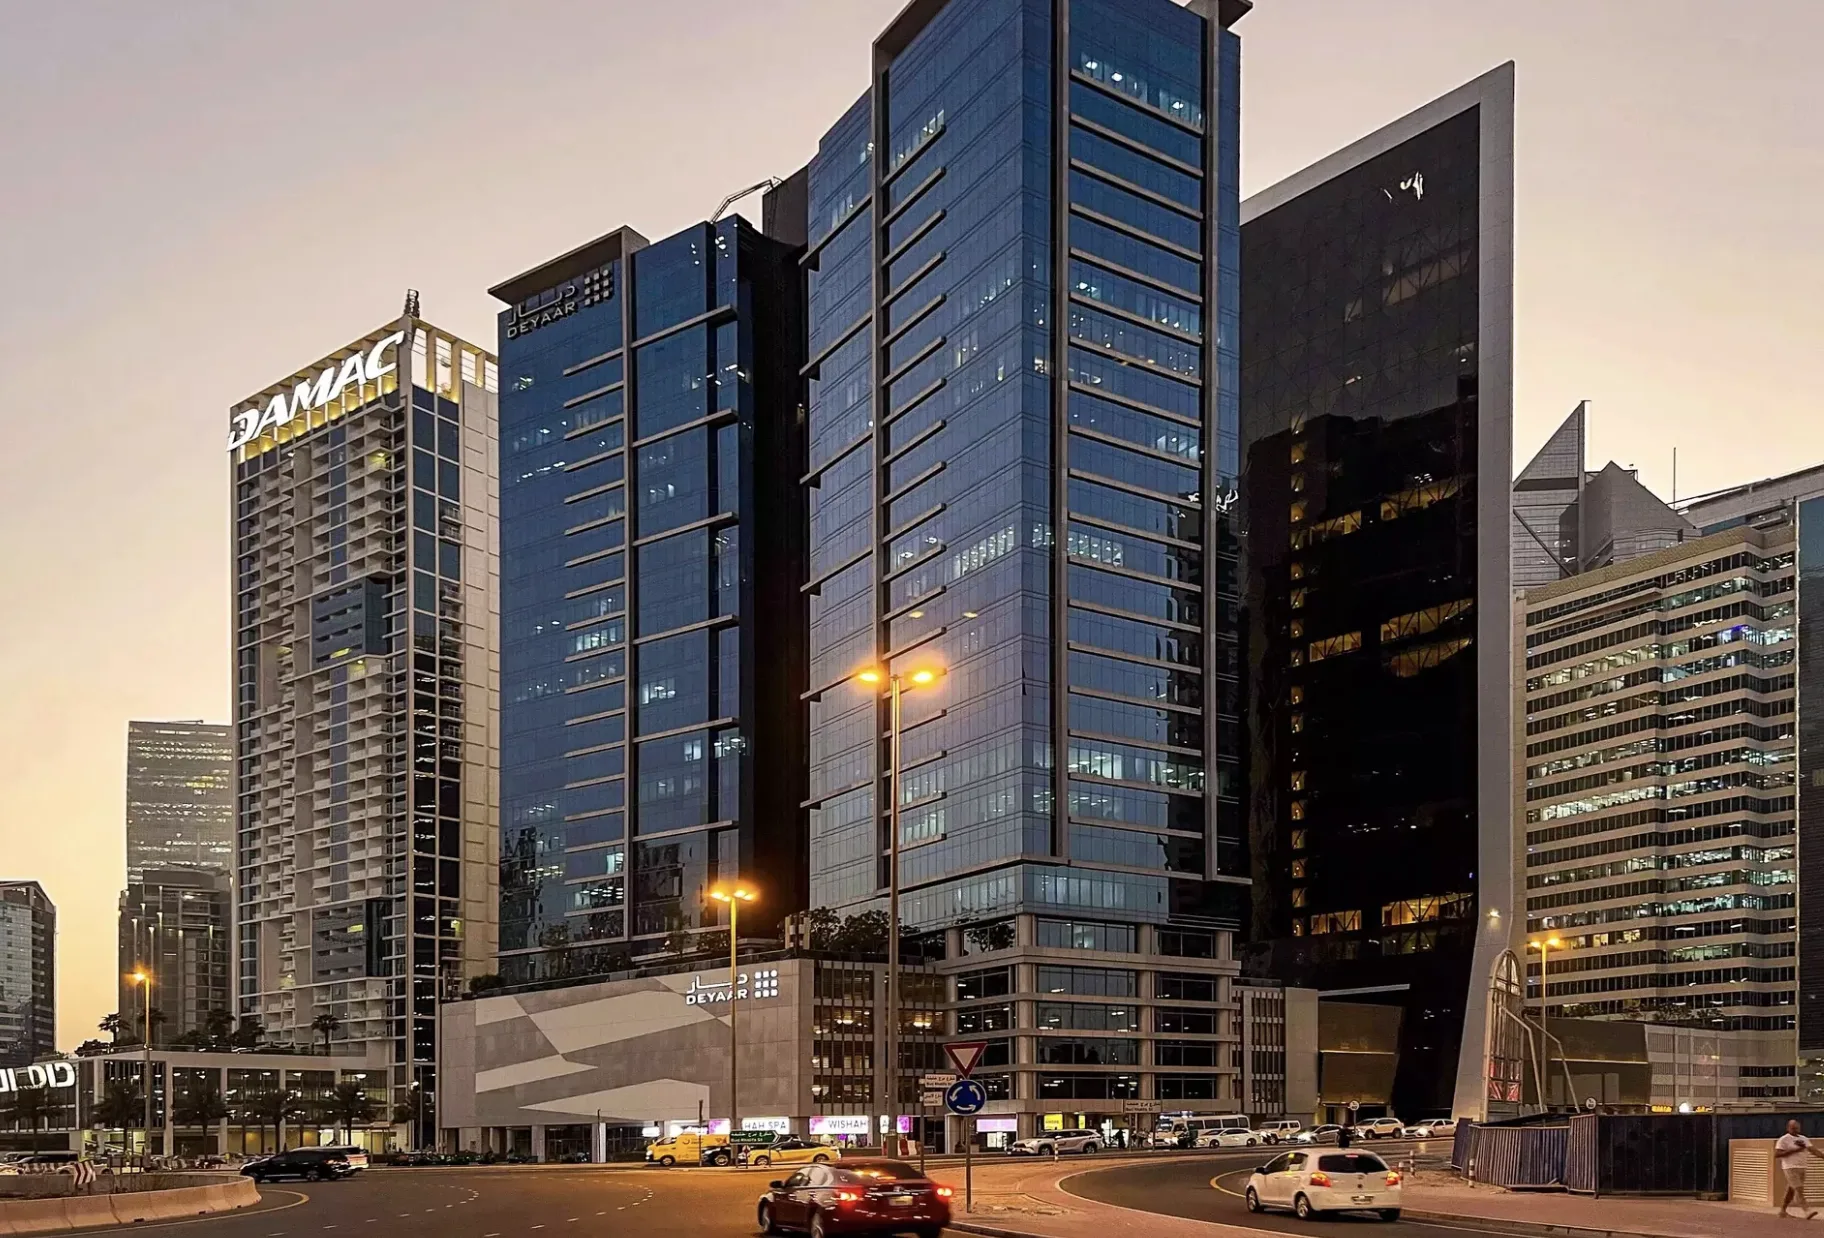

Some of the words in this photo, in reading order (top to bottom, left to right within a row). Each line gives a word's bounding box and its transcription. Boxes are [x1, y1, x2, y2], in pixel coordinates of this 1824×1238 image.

[507, 301, 576, 338] DEYAAR
[226, 330, 405, 452] DAMAC
[686, 989, 748, 1005] DEYAAR
[768, 1121, 786, 1130] SPA
[828, 1119, 867, 1129] WISHAH
